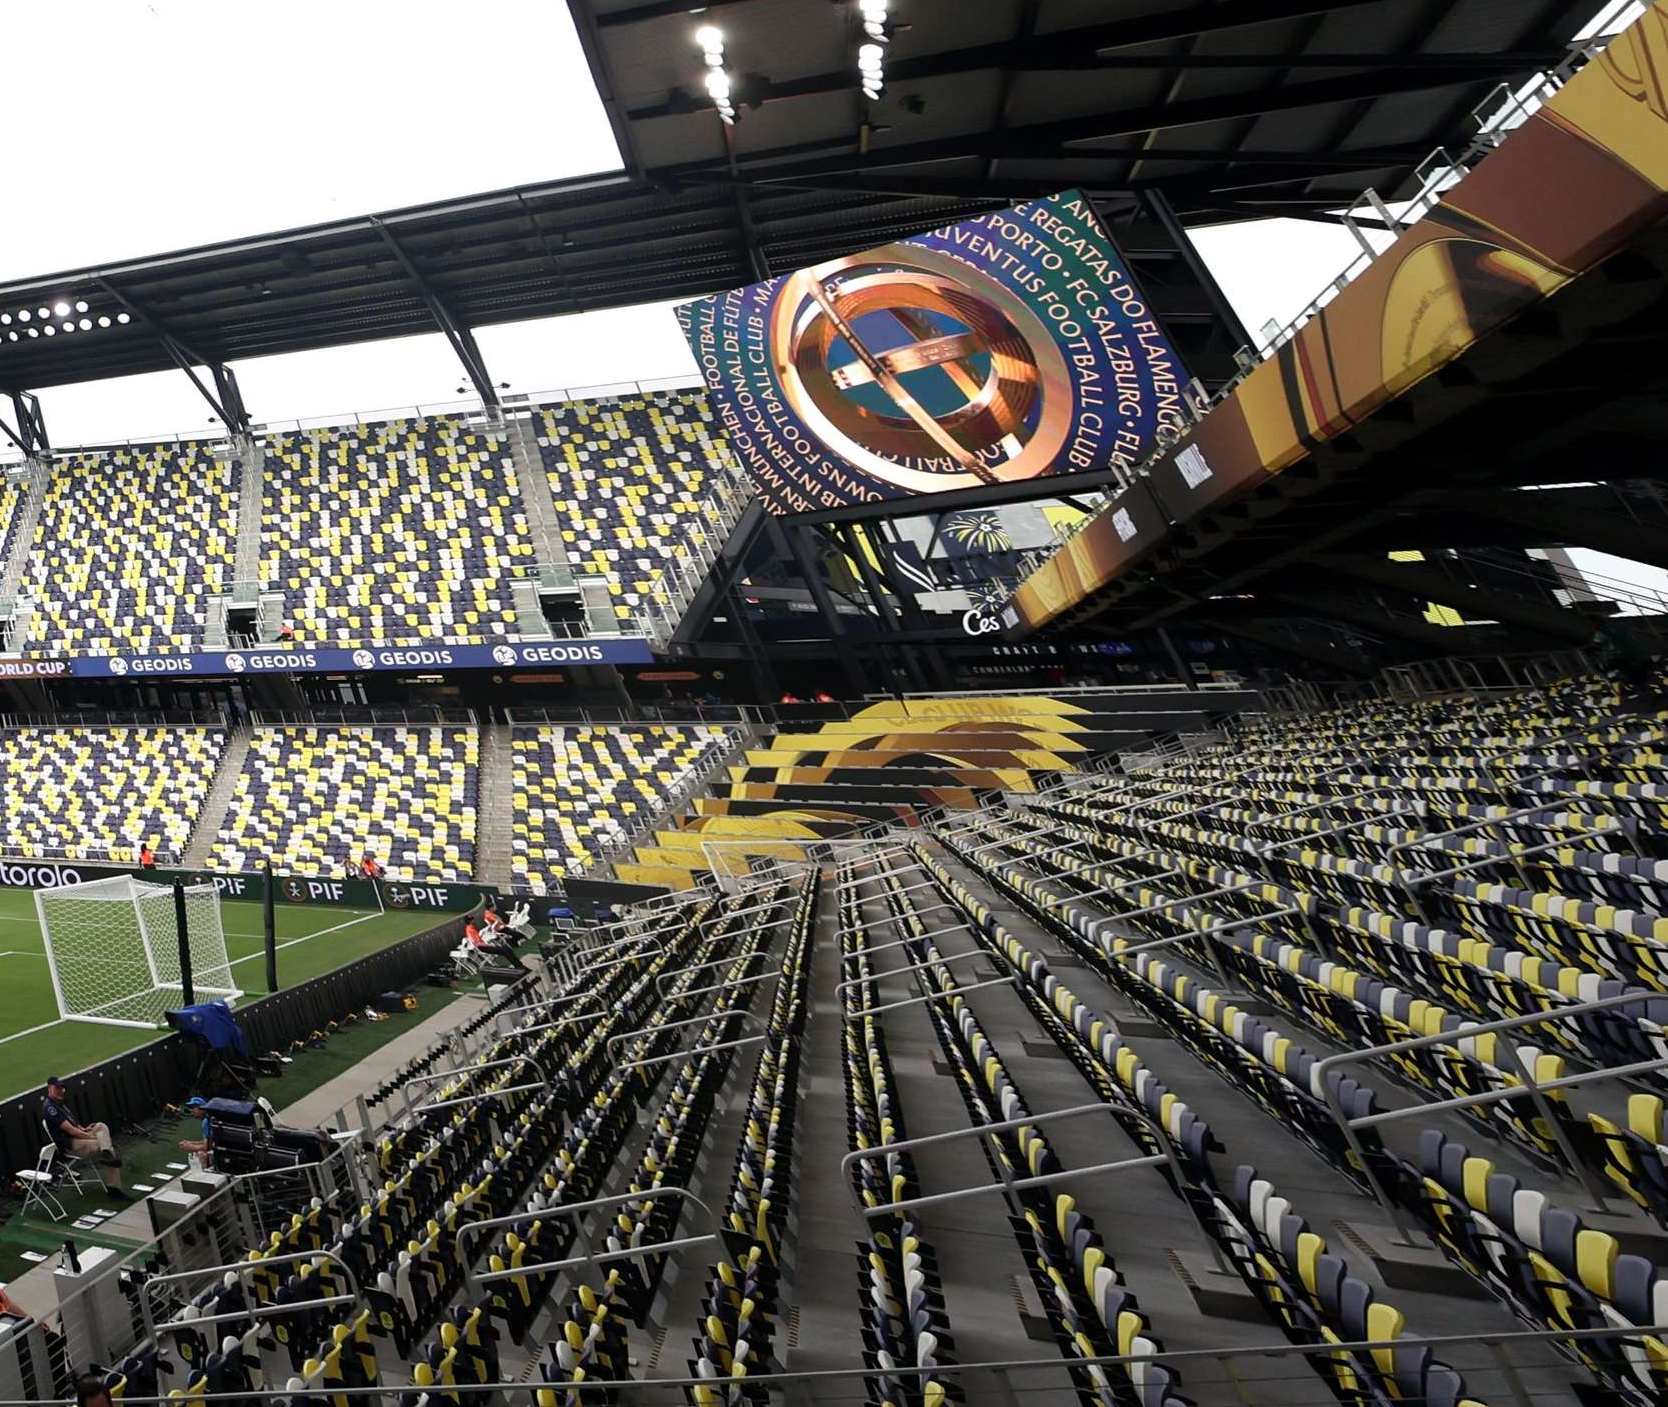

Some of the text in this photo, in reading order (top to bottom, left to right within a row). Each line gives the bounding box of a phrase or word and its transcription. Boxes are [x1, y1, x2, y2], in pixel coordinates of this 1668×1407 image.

[1030, 208, 1121, 284] REGATAS
[1111, 285, 1145, 317] DO
[987, 214, 1062, 270] PORTO
[1066, 279, 1099, 306] FC
[1086, 306, 1142, 417] SALZBURG
[700, 302, 724, 390] FOOTBALL
[724, 330, 739, 353] DE
[748, 316, 764, 364] CLUB
[1037, 291, 1104, 407] FOOTBALL
[727, 357, 816, 490] INTERNACIONAL
[753, 367, 821, 464] FOOTBALL
[718, 403, 784, 491] MÜNCHEN
[1068, 412, 1103, 468] CLUB
[36, 662, 65, 675] CUP
[132, 658, 193, 672] GEODIS
[249, 654, 317, 669] GEODIS
[380, 650, 453, 666] GEODIS
[522, 646, 604, 663] GEODIS
[212, 877, 245, 895] PIF
[308, 881, 344, 900] PIF
[410, 887, 449, 907] PIF
